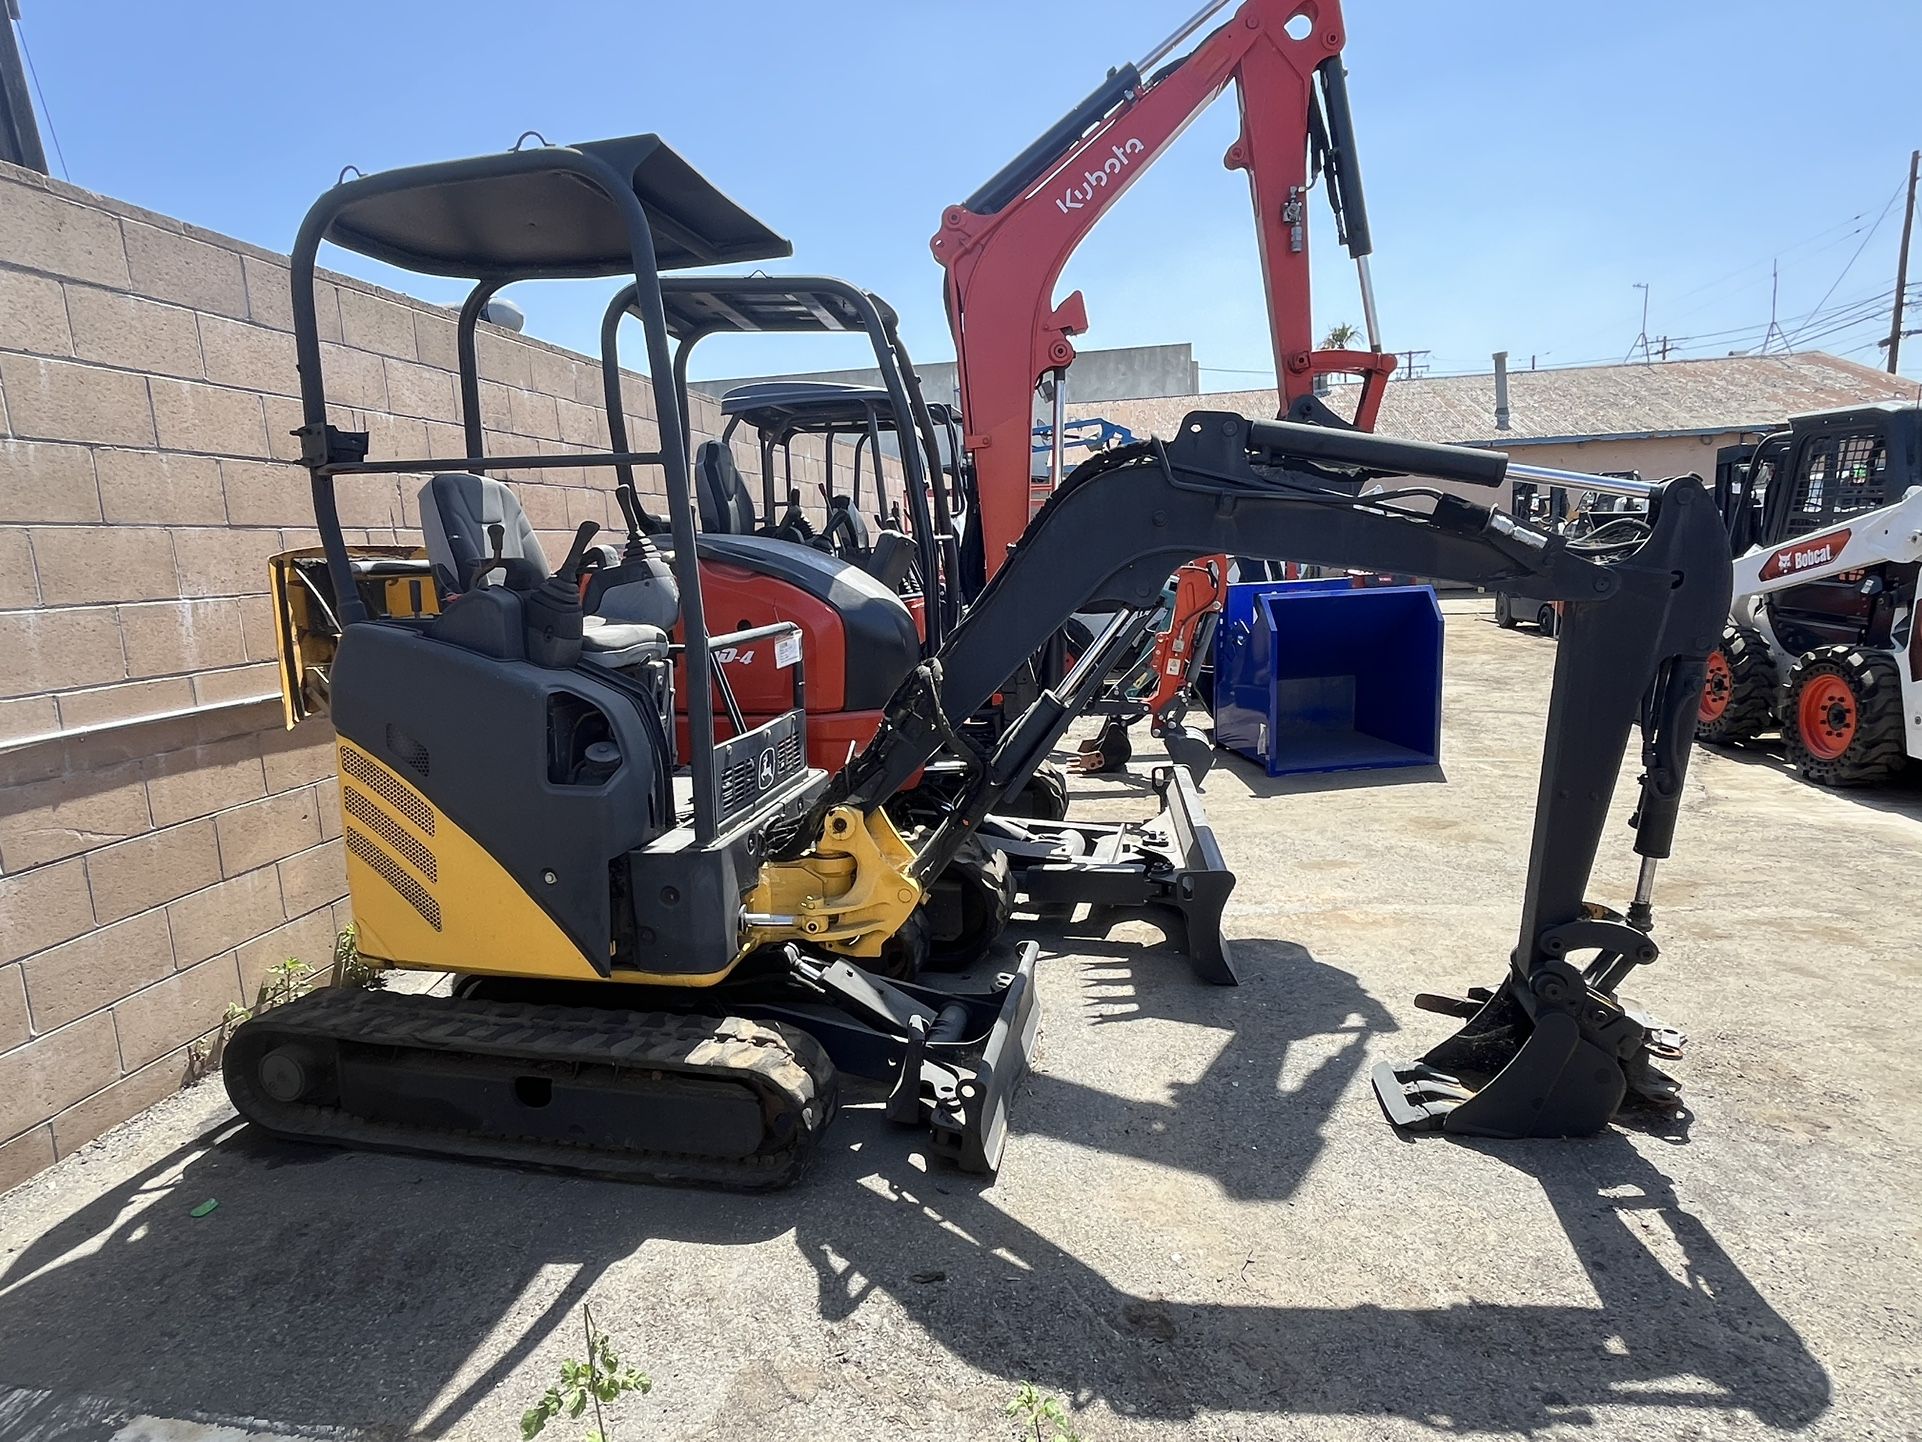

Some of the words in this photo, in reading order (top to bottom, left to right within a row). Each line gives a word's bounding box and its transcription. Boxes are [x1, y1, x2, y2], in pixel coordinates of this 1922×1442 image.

[1055, 138, 1145, 214] Kubota
[1794, 544, 1832, 569] Bobcat
[714, 647, 755, 665] 0-4
